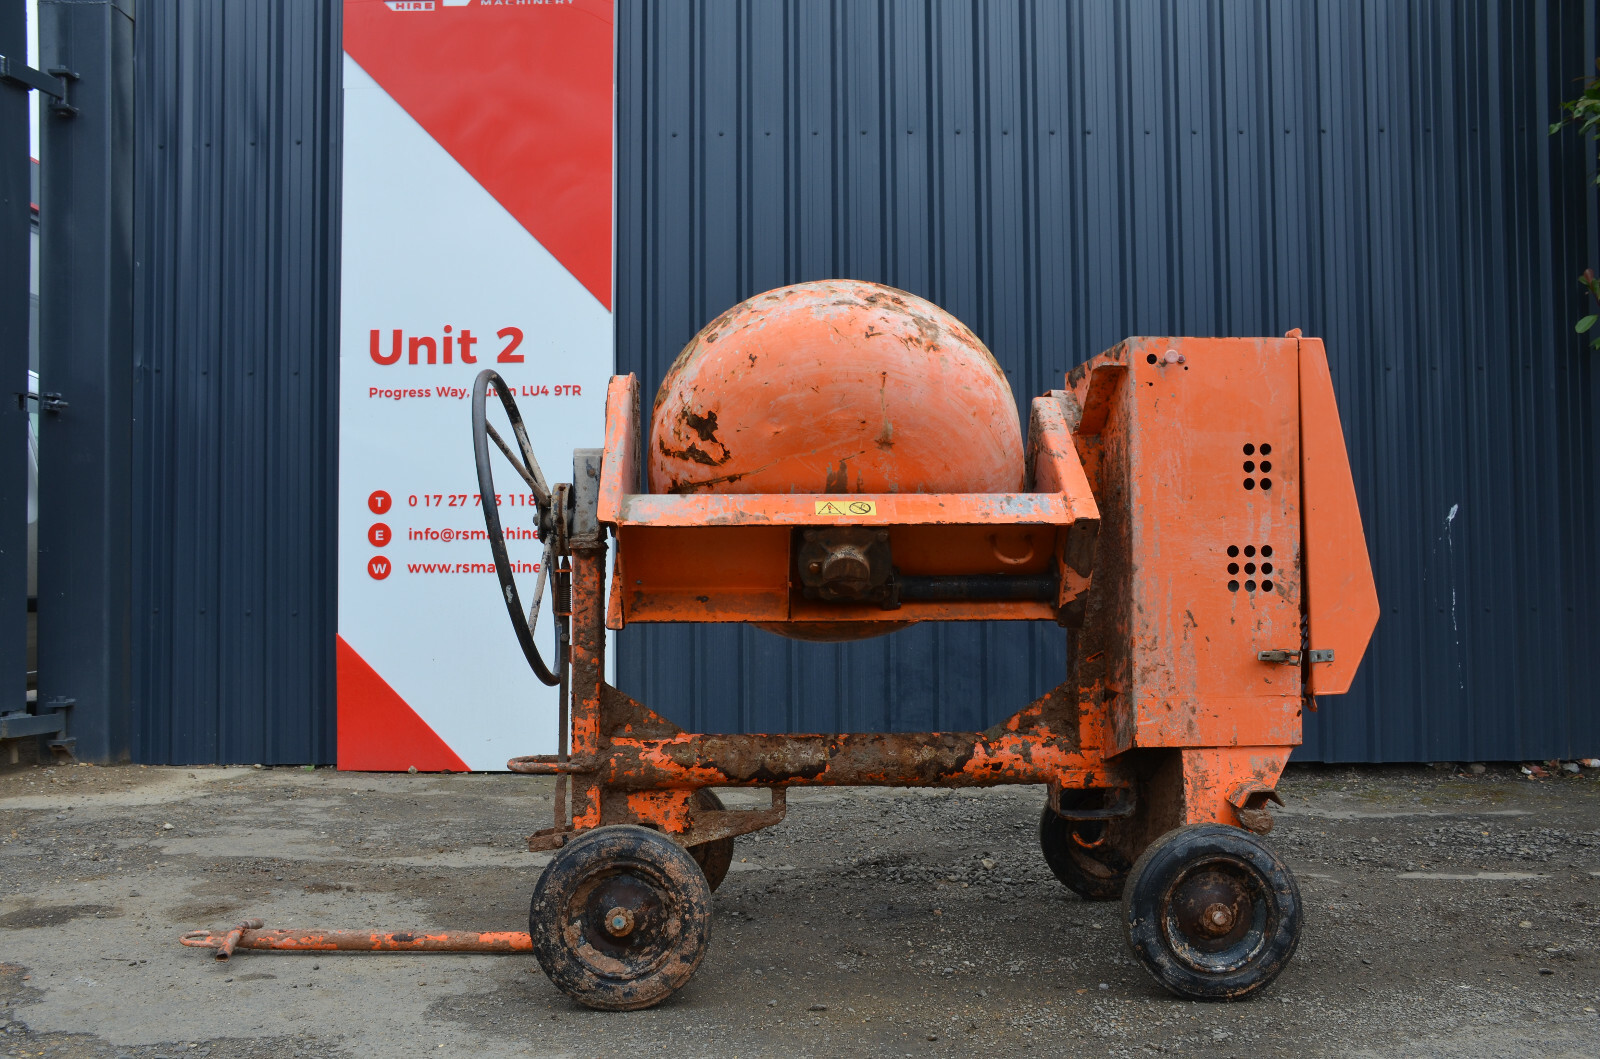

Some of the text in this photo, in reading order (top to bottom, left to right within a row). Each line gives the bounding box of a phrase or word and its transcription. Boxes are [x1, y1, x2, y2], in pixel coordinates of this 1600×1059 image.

[369, 324, 525, 366] Unit 2
[369, 386, 432, 401] Progress
[436, 386, 470, 400] Way,
[522, 385, 550, 397] LU4
[554, 384, 582, 397] 9TR
[375, 496, 385, 508] T
[408, 494, 418, 507] 0
[473, 493, 502, 507] 73
[375, 530, 384, 541] E
[372, 563, 387, 574] W
